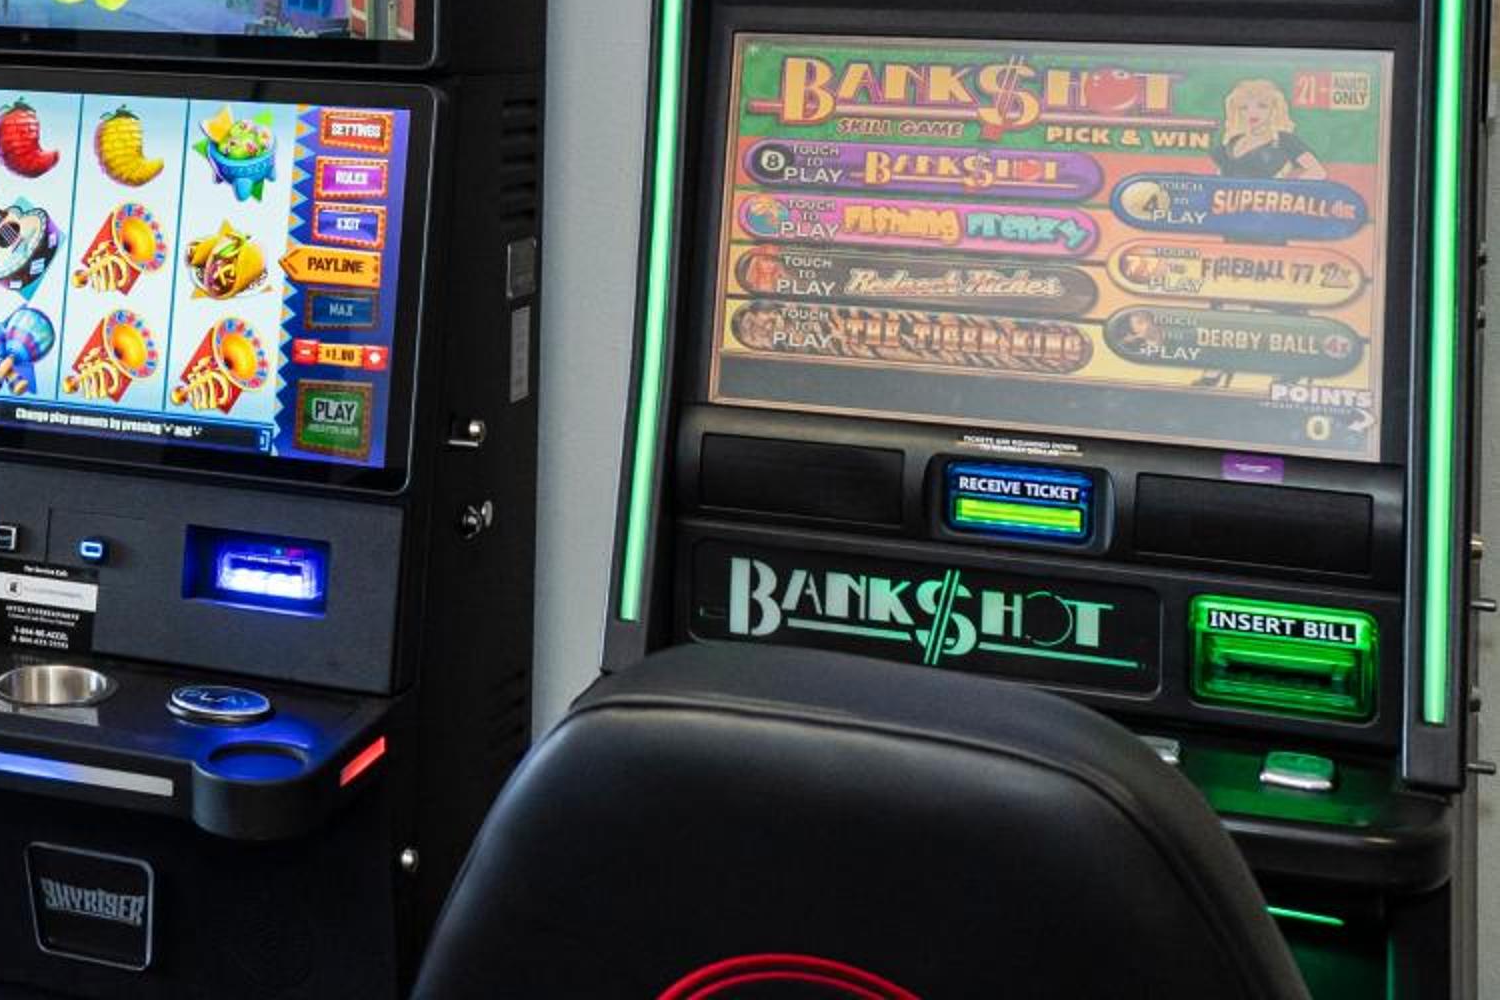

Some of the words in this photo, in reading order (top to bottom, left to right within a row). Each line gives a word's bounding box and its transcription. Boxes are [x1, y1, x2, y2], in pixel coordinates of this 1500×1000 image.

[1332, 89, 1368, 106] ONLY
[331, 122, 381, 139] SETTINGS
[836, 118, 893, 137] SKILL
[900, 119, 964, 138] GAME
[1046, 126, 1110, 146] PICK
[1119, 128, 1143, 147] &
[1151, 130, 1211, 149] WIN
[793, 144, 840, 155] TOUCH
[784, 167, 842, 183] PLAY
[789, 199, 836, 210] TOUCH
[1212, 189, 1328, 218] SUPERBALL
[336, 217, 361, 231] EXIT
[1153, 209, 1207, 225] PLAY
[780, 221, 838, 238] PLAY
[307, 256, 365, 275] PAYLINE
[784, 256, 832, 267] TOUCH
[1202, 257, 1284, 282] FIREBALL
[1291, 263, 1314, 283] 77
[776, 279, 836, 296] PLAY
[329, 303, 354, 318] MAX
[781, 308, 829, 320] TOUCH
[772, 332, 833, 348] PLAY
[1196, 327, 1263, 351] DERBY
[1269, 331, 1320, 355] BALL
[1146, 344, 1200, 359] PLAY
[1271, 383, 1373, 408] POINTS
[314, 399, 357, 424] PLAY
[15, 407, 49, 423] Change
[50, 410, 68, 425] play
[110, 417, 121, 431] by
[122, 418, 162, 435] pressing
[173, 425, 193, 437] and
[1306, 415, 1331, 441] 0
[959, 475, 1021, 496] RECEIVE
[1024, 482, 1079, 501] TICKET
[1210, 610, 1296, 636] INSERT
[1303, 621, 1354, 643] BILL
[40, 877, 146, 927] SKYRISER
